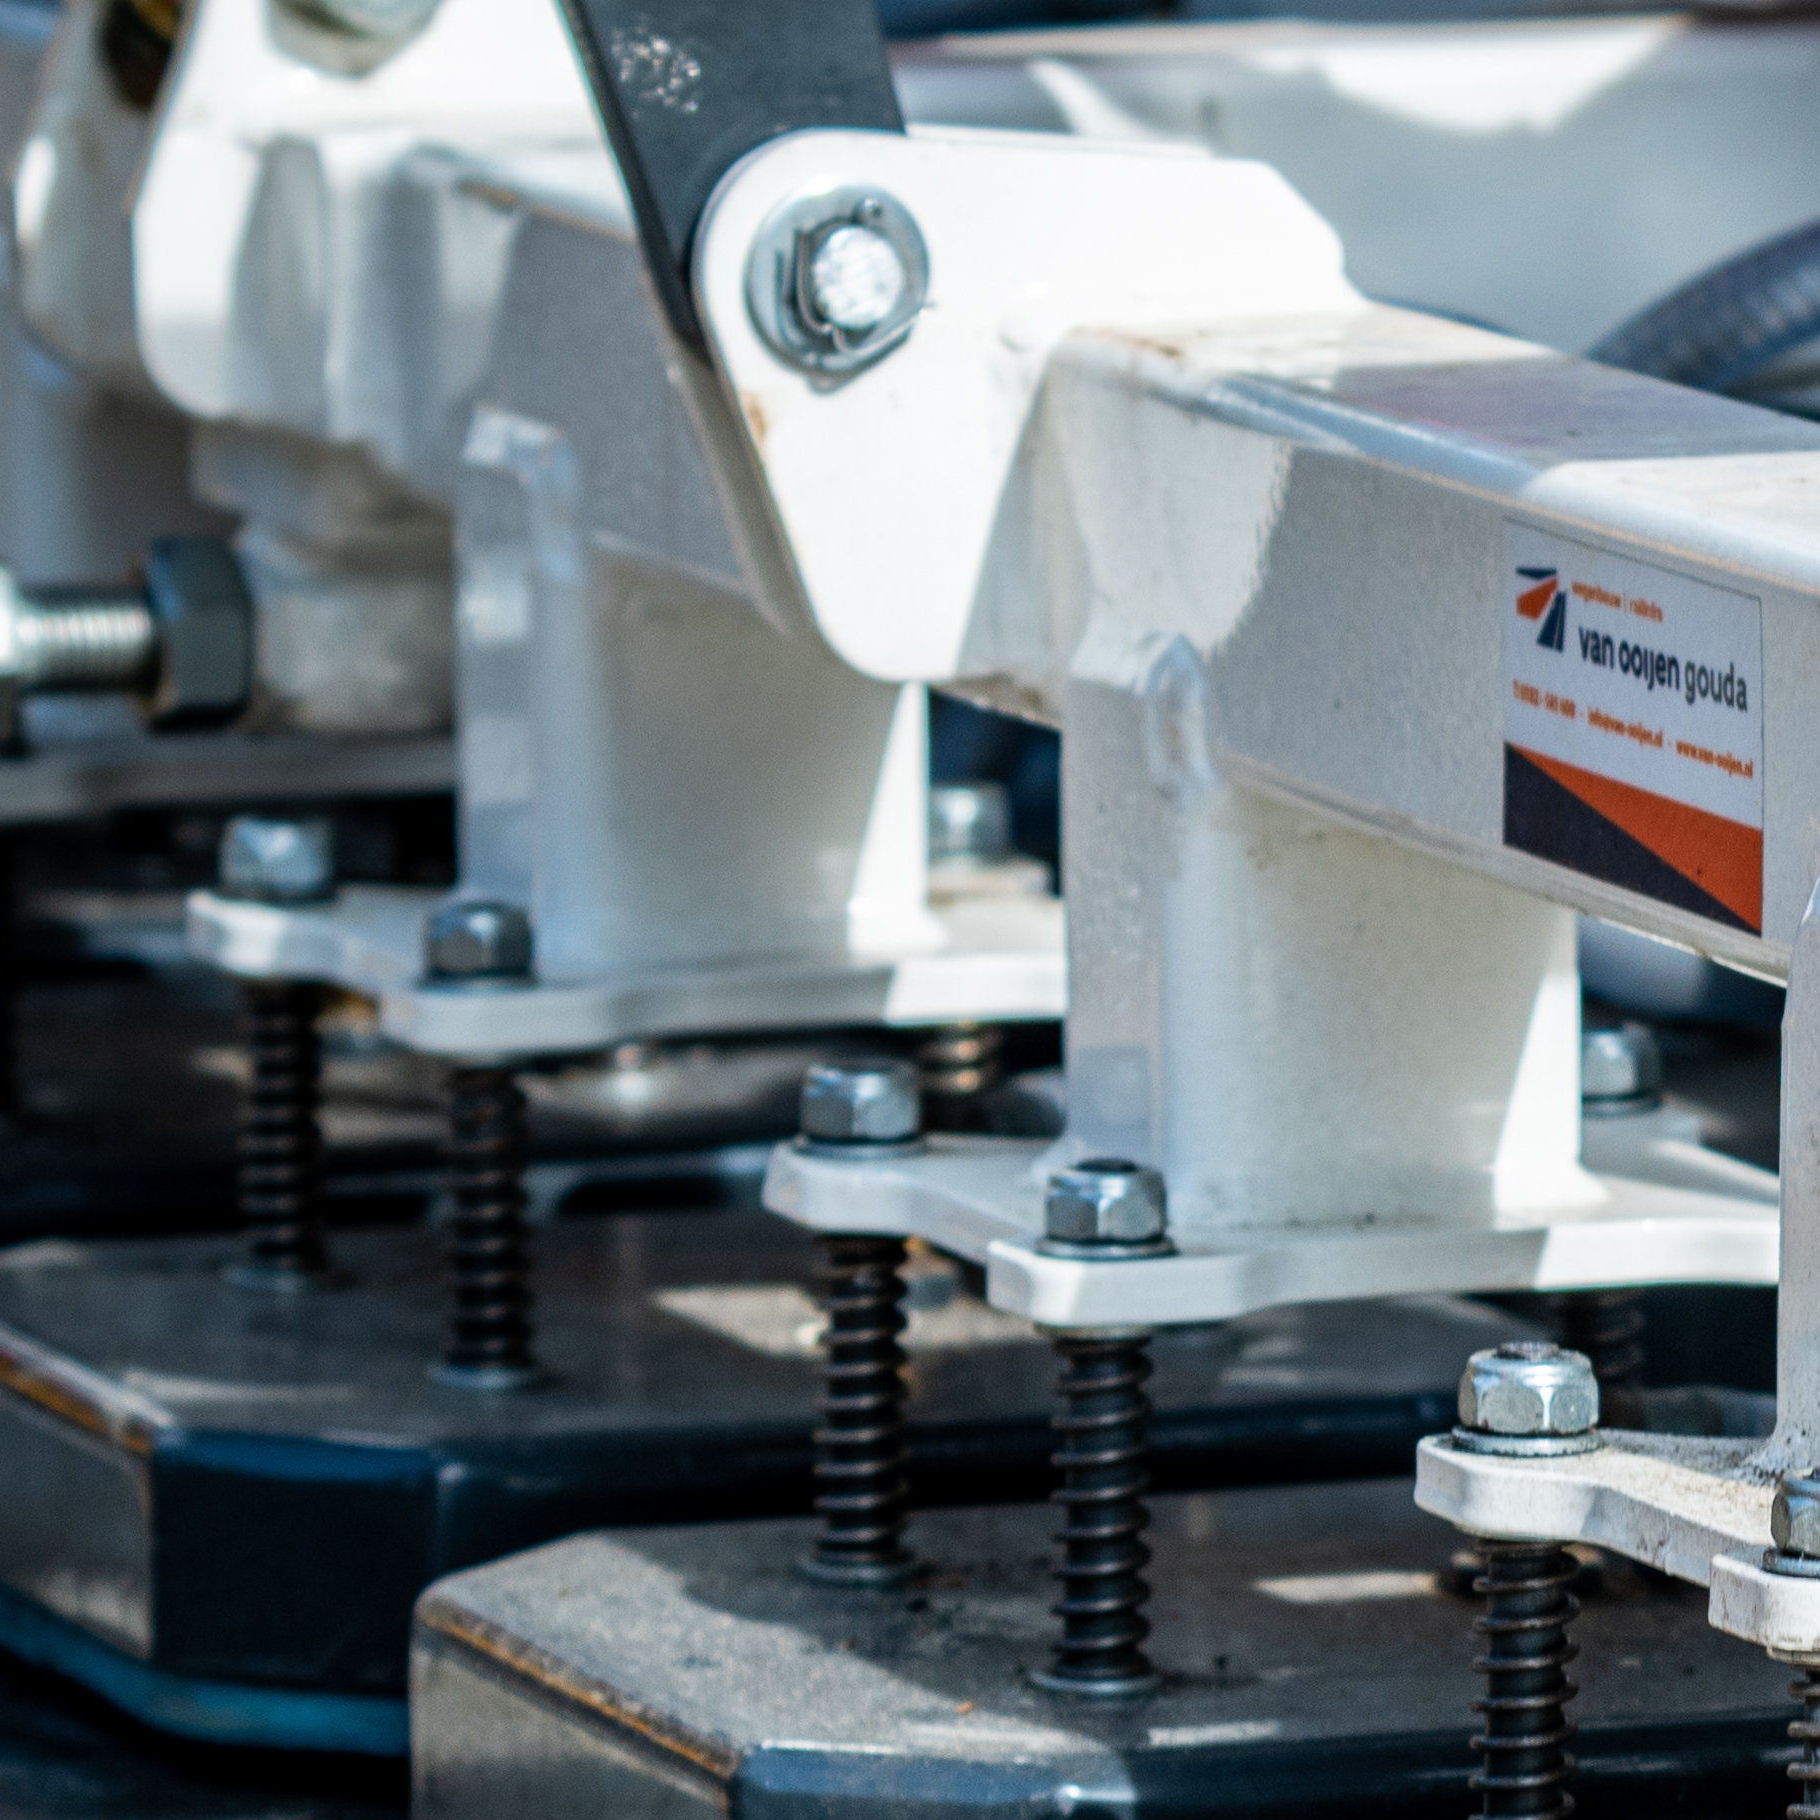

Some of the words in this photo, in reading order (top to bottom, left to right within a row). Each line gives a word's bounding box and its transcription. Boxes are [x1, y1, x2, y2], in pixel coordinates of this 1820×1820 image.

[1579, 626, 1614, 669] van
[1618, 639, 1680, 691] ooijen
[1685, 660, 1748, 713] gouda
